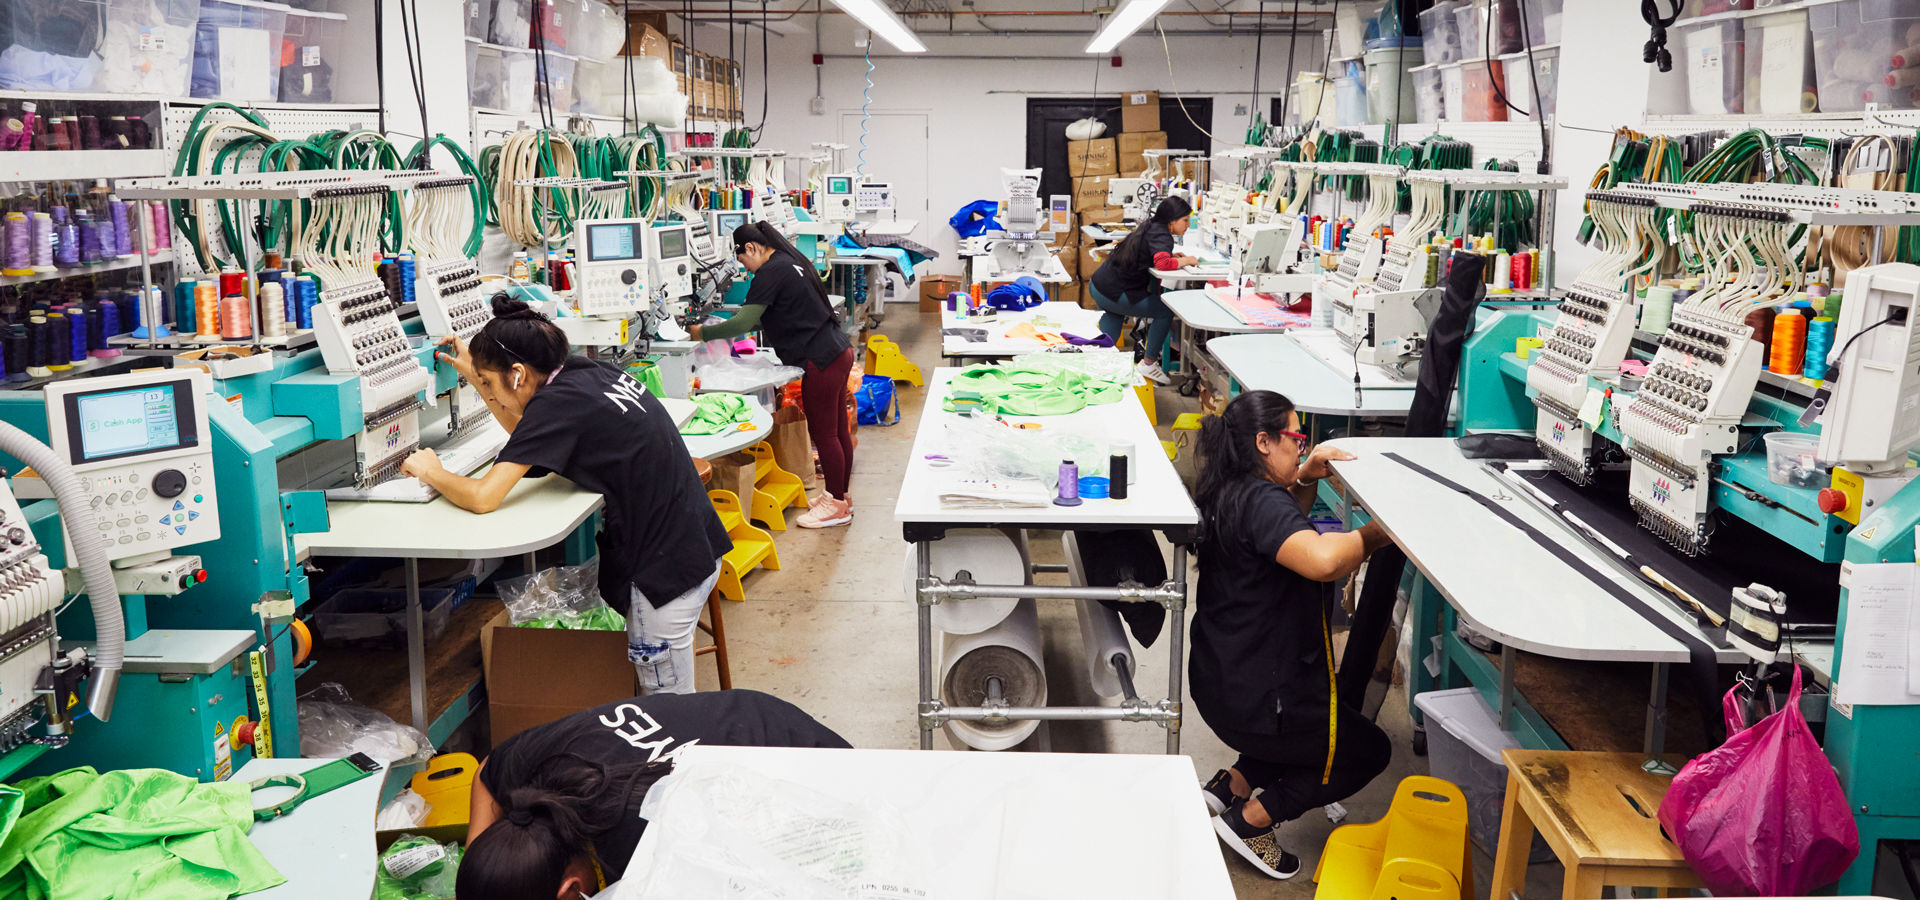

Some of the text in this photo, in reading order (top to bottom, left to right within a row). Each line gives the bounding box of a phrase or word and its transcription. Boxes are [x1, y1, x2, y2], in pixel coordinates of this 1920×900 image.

[1077, 152, 1108, 161] SHINING
[1082, 189, 1108, 197] SHININ
[603, 371, 647, 413] NYE
[103, 418, 126, 428] Cash
[126, 417, 143, 425] App
[250, 656, 257, 666] 32
[252, 670, 259, 679] 33
[255, 683, 262, 692] 34
[258, 696, 266, 706] 35
[261, 710, 268, 719] 36
[882, 884, 899, 892] 0255
